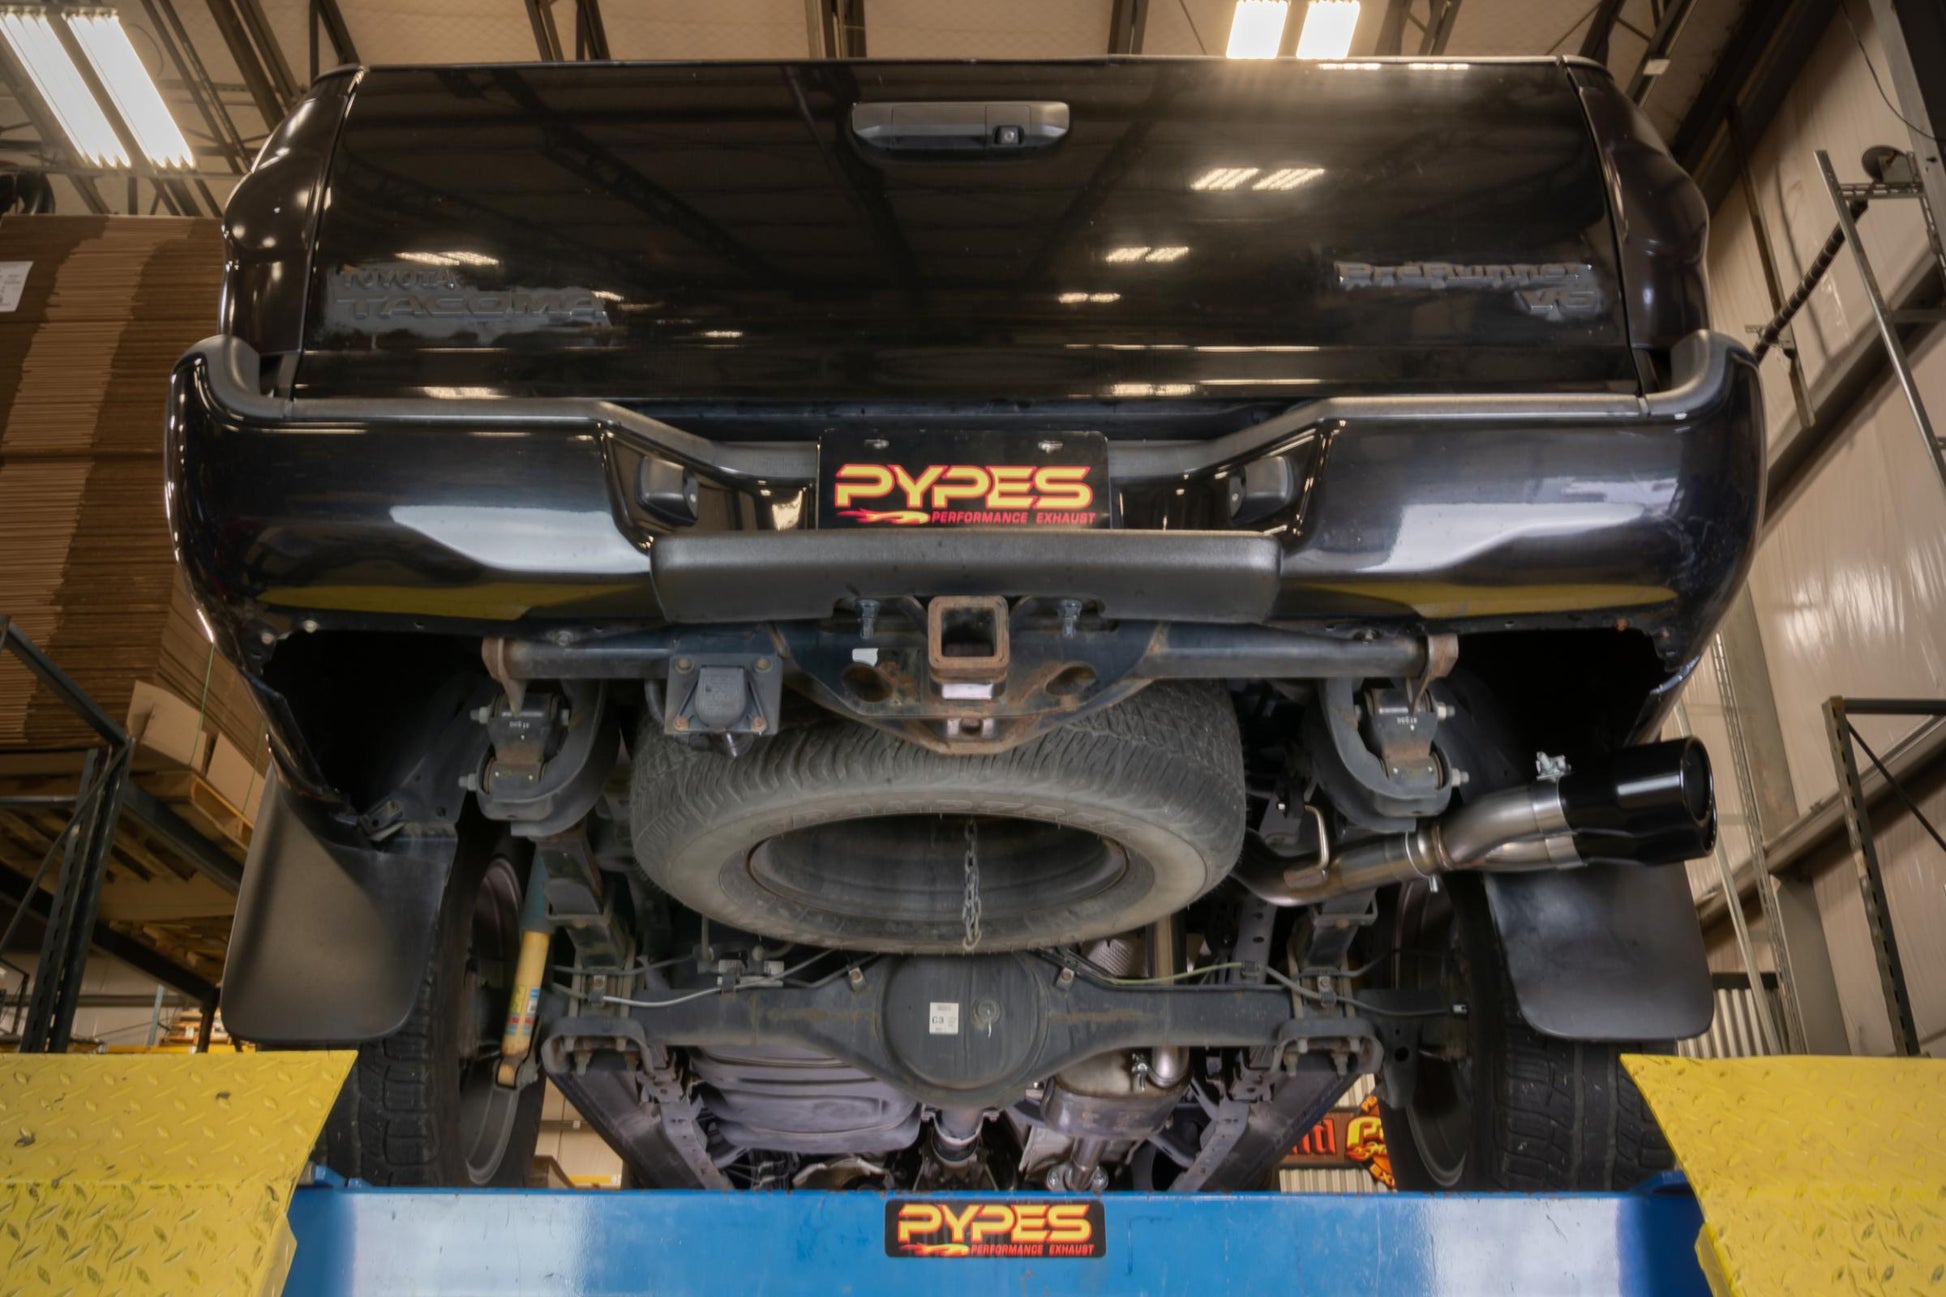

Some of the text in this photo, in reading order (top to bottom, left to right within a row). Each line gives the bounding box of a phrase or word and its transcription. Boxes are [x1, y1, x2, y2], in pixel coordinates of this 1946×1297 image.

[341, 269, 456, 289] TOYOTA
[335, 293, 609, 318] TACOMA
[834, 463, 1093, 509] PYPES
[931, 511, 1096, 524] PERFORMANCE EXHAUST
[897, 1203, 1093, 1243] PYPES
[970, 1243, 1094, 1257] PERFORMANCE EXHAUST
